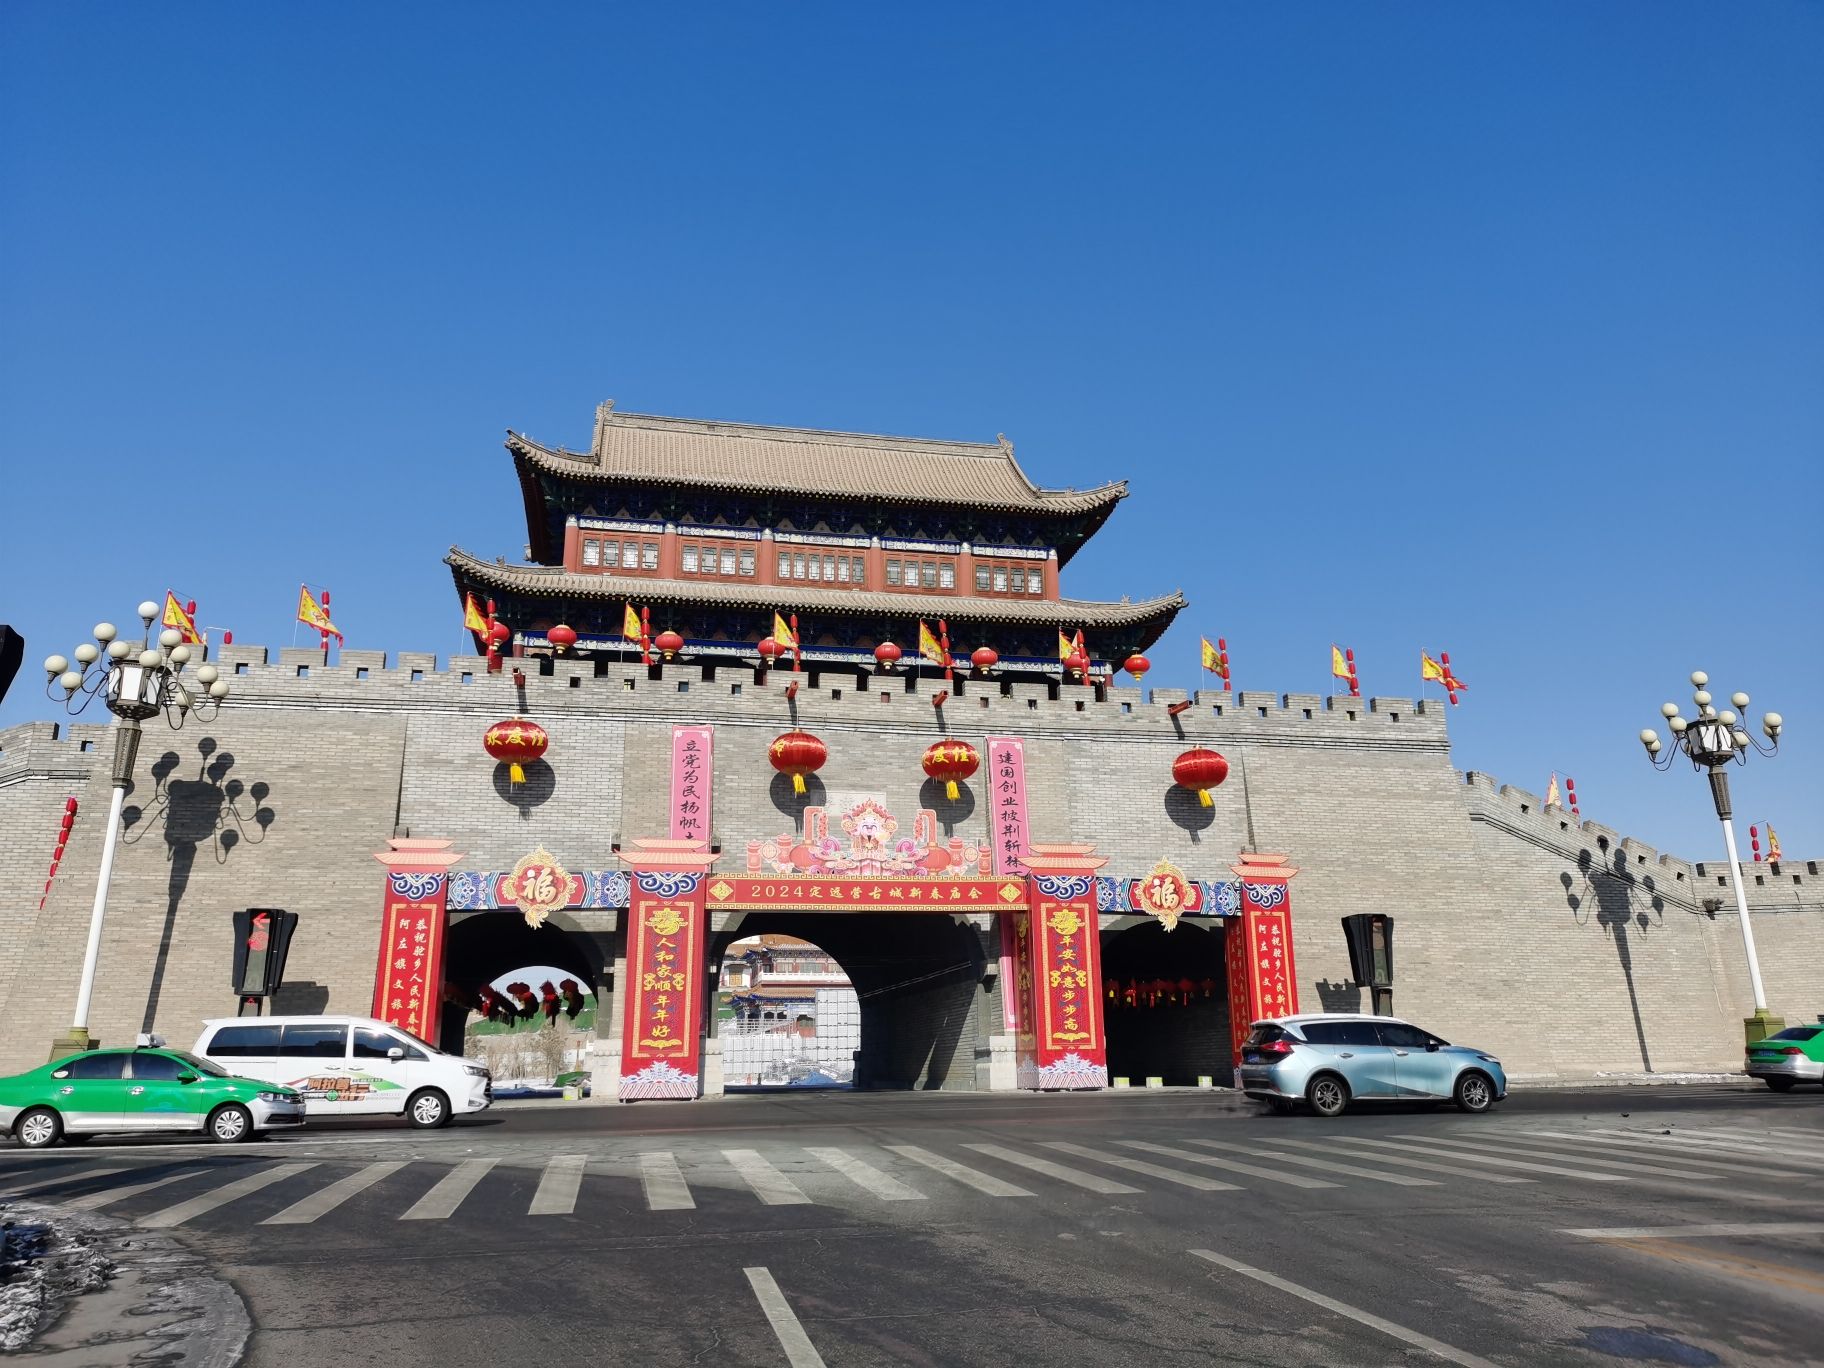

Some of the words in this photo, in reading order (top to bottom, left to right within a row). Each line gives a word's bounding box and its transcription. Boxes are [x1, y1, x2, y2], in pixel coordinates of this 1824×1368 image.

[522, 867, 557, 904] 福
[1150, 876, 1180, 909] 福
[651, 937, 677, 1038] 人和家顺年年好
[1058, 935, 1079, 1031] 平安如意步步高
